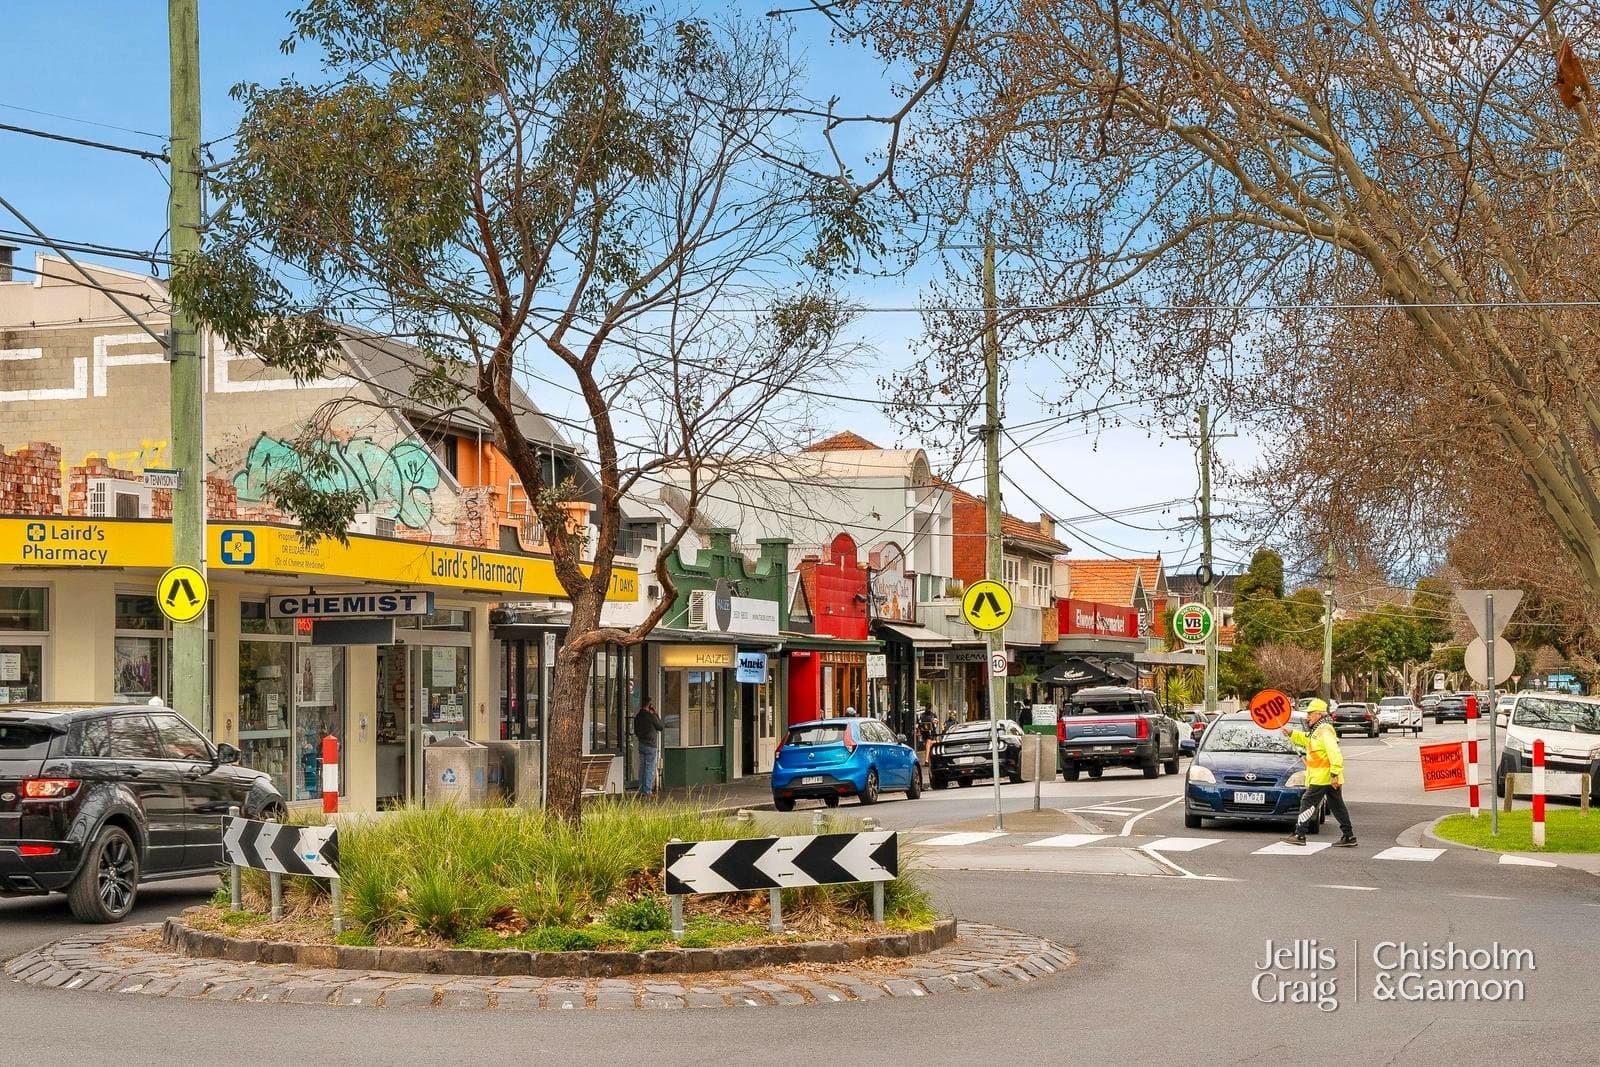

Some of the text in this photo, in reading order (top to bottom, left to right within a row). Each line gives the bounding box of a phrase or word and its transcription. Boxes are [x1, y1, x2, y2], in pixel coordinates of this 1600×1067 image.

[51, 525, 105, 541] Laird's
[23, 543, 108, 565] Pharmacy
[431, 551, 524, 591] Laird's Pharmacy
[613, 574, 634, 594] 7 DAYS
[279, 595, 417, 615] CHEMIST
[1184, 618, 1201, 628] VB
[696, 653, 729, 664] HAIZE
[992, 658, 1005, 668] 40
[1254, 695, 1285, 724] STOP
[1424, 751, 1461, 764] CHILDREN
[1426, 768, 1463, 781] CROSSING
